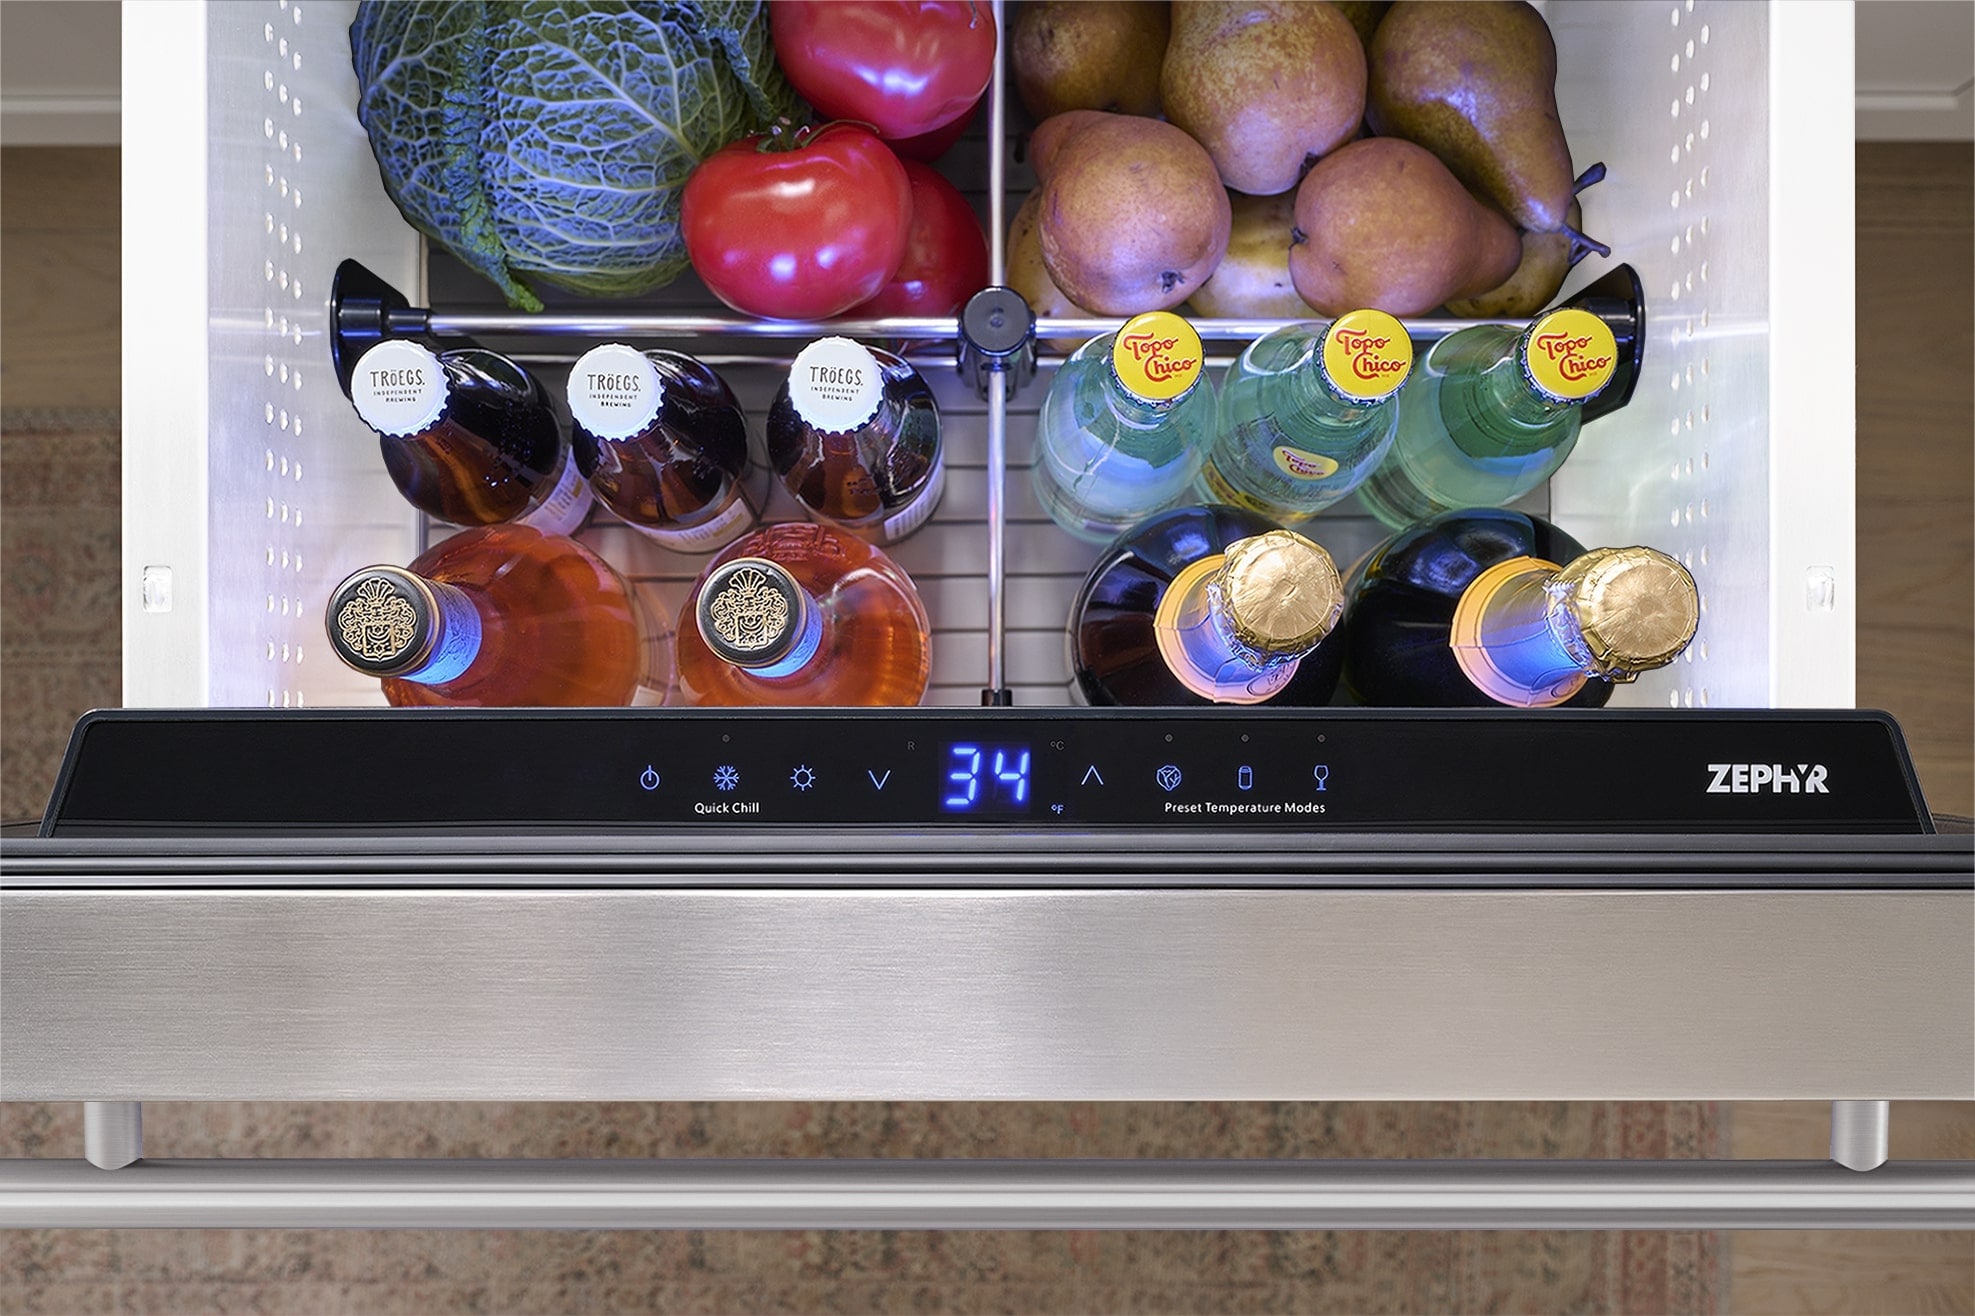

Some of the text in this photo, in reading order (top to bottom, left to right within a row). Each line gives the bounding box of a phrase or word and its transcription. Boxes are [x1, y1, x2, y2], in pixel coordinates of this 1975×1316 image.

[1123, 332, 1179, 360] Topo
[1336, 329, 1391, 356] Topo
[1537, 331, 1593, 360] Topo
[1144, 354, 1197, 382] Chico
[1353, 352, 1406, 380] Chico
[1559, 353, 1612, 381] Chico
[373, 388, 422, 396] INDEPENDENT
[811, 386, 860, 395] INDEPENDENT
[822, 394, 853, 402] BREWING
[946, 747, 1030, 806] 34
[1706, 763, 1830, 793] ZEPHYR
[694, 802, 760, 815] Quick Chill
[1050, 803, 1065, 815] °F
[1164, 802, 1326, 815] Preset Temperature Modes
